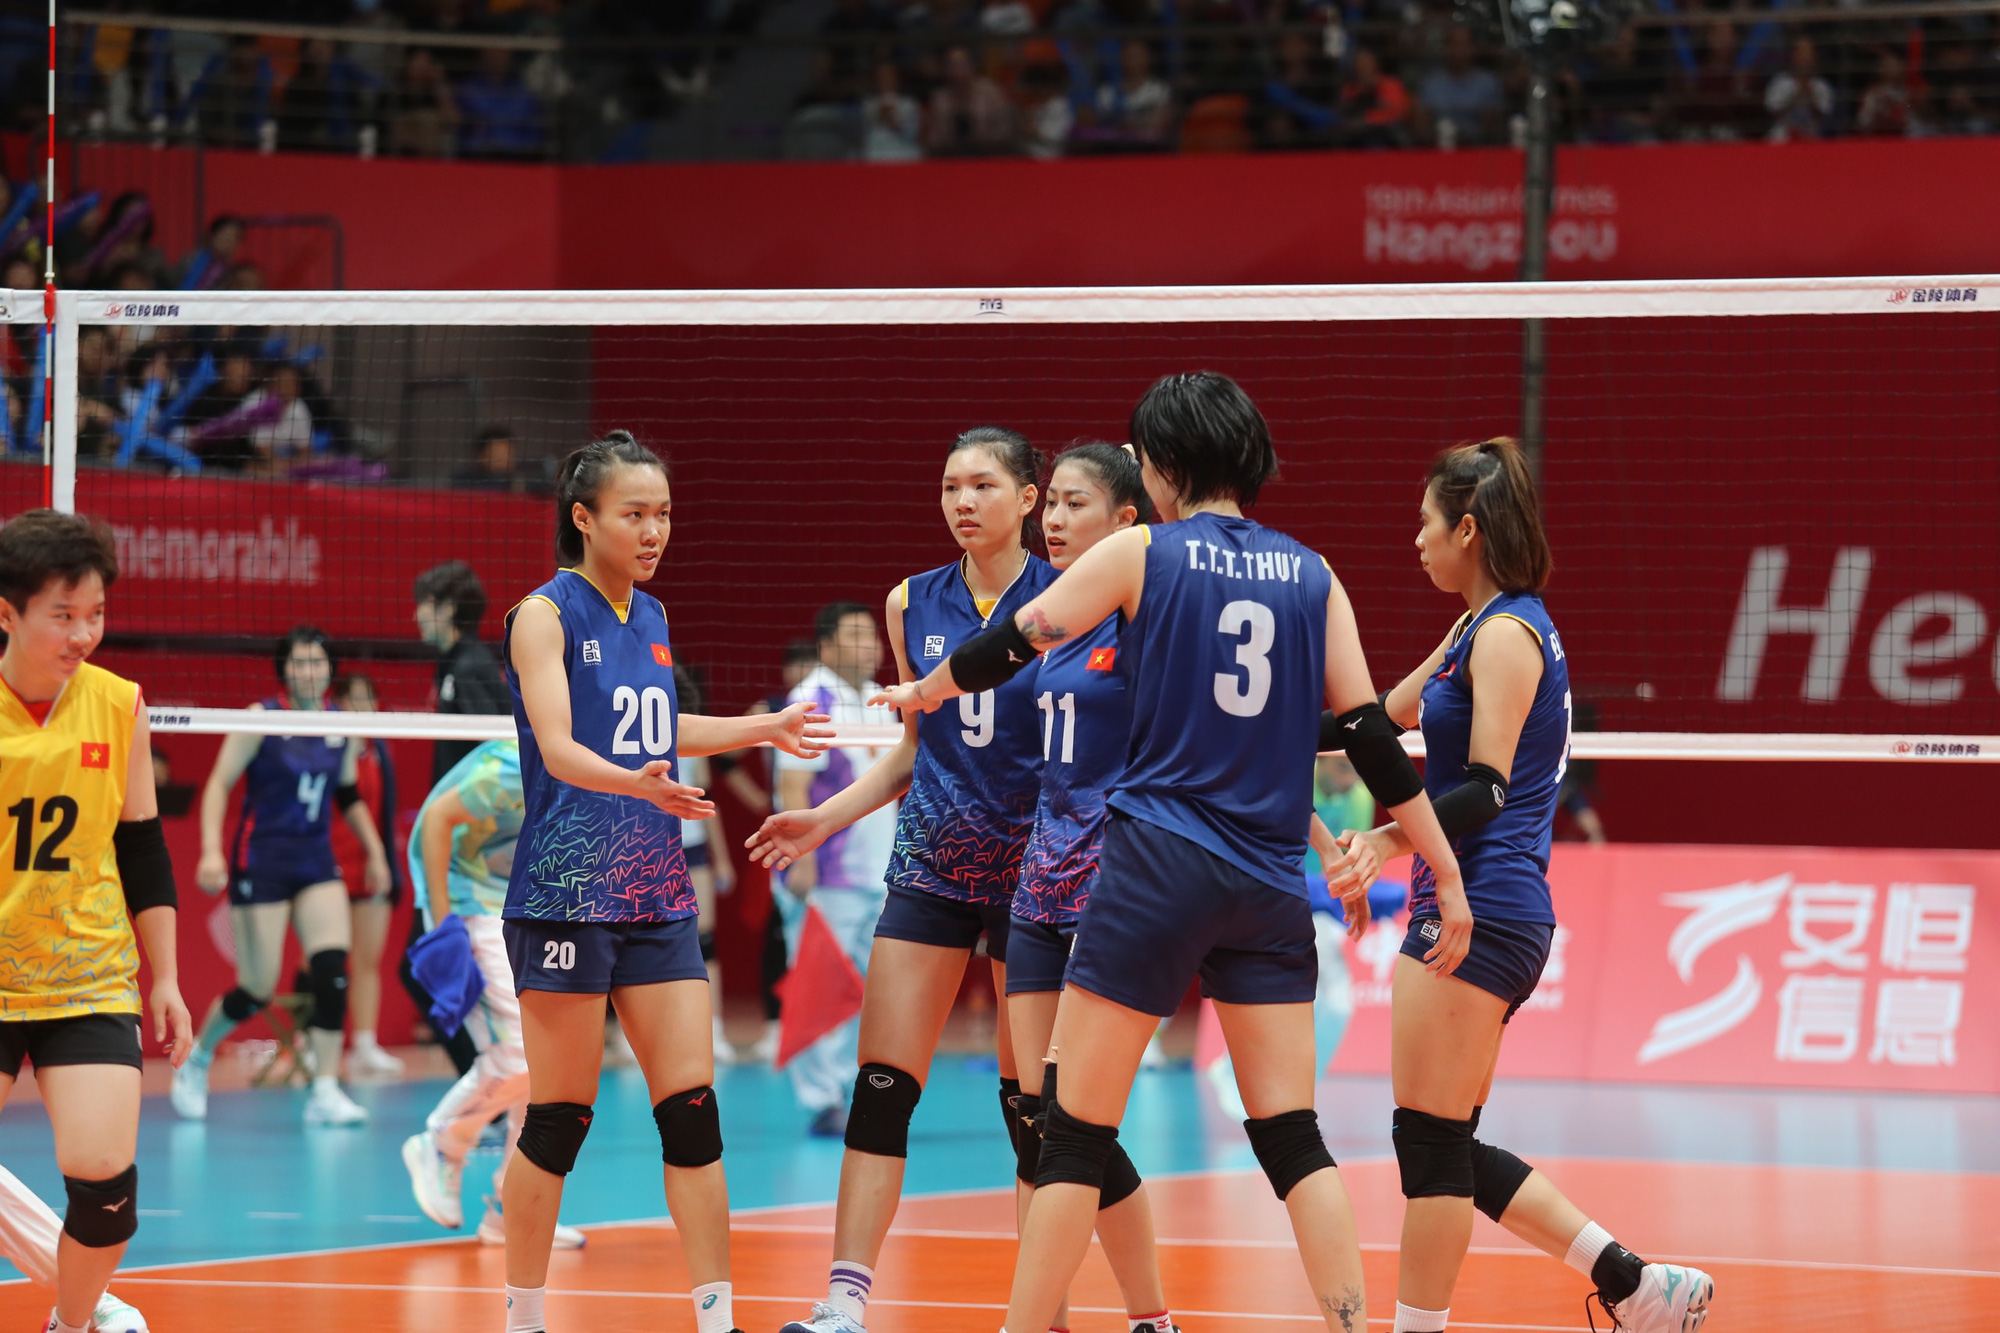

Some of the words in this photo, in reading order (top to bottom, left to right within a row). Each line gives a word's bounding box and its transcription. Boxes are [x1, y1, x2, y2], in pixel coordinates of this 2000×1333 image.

[1512, 184, 1617, 216] mes
[1365, 217, 1618, 271] Hangzou
[1186, 540, 1301, 584] T.T.T.THUY
[1213, 599, 1276, 718] 3
[1714, 544, 2000, 706] He
[612, 685, 673, 756] 20
[958, 687, 995, 748] 9
[1036, 690, 1076, 764] 11
[297, 770, 328, 823] 4
[8, 795, 79, 872] 12
[543, 940, 576, 970] 20
[1780, 881, 1976, 973] 安恒
[1774, 974, 1964, 1067] 信息
